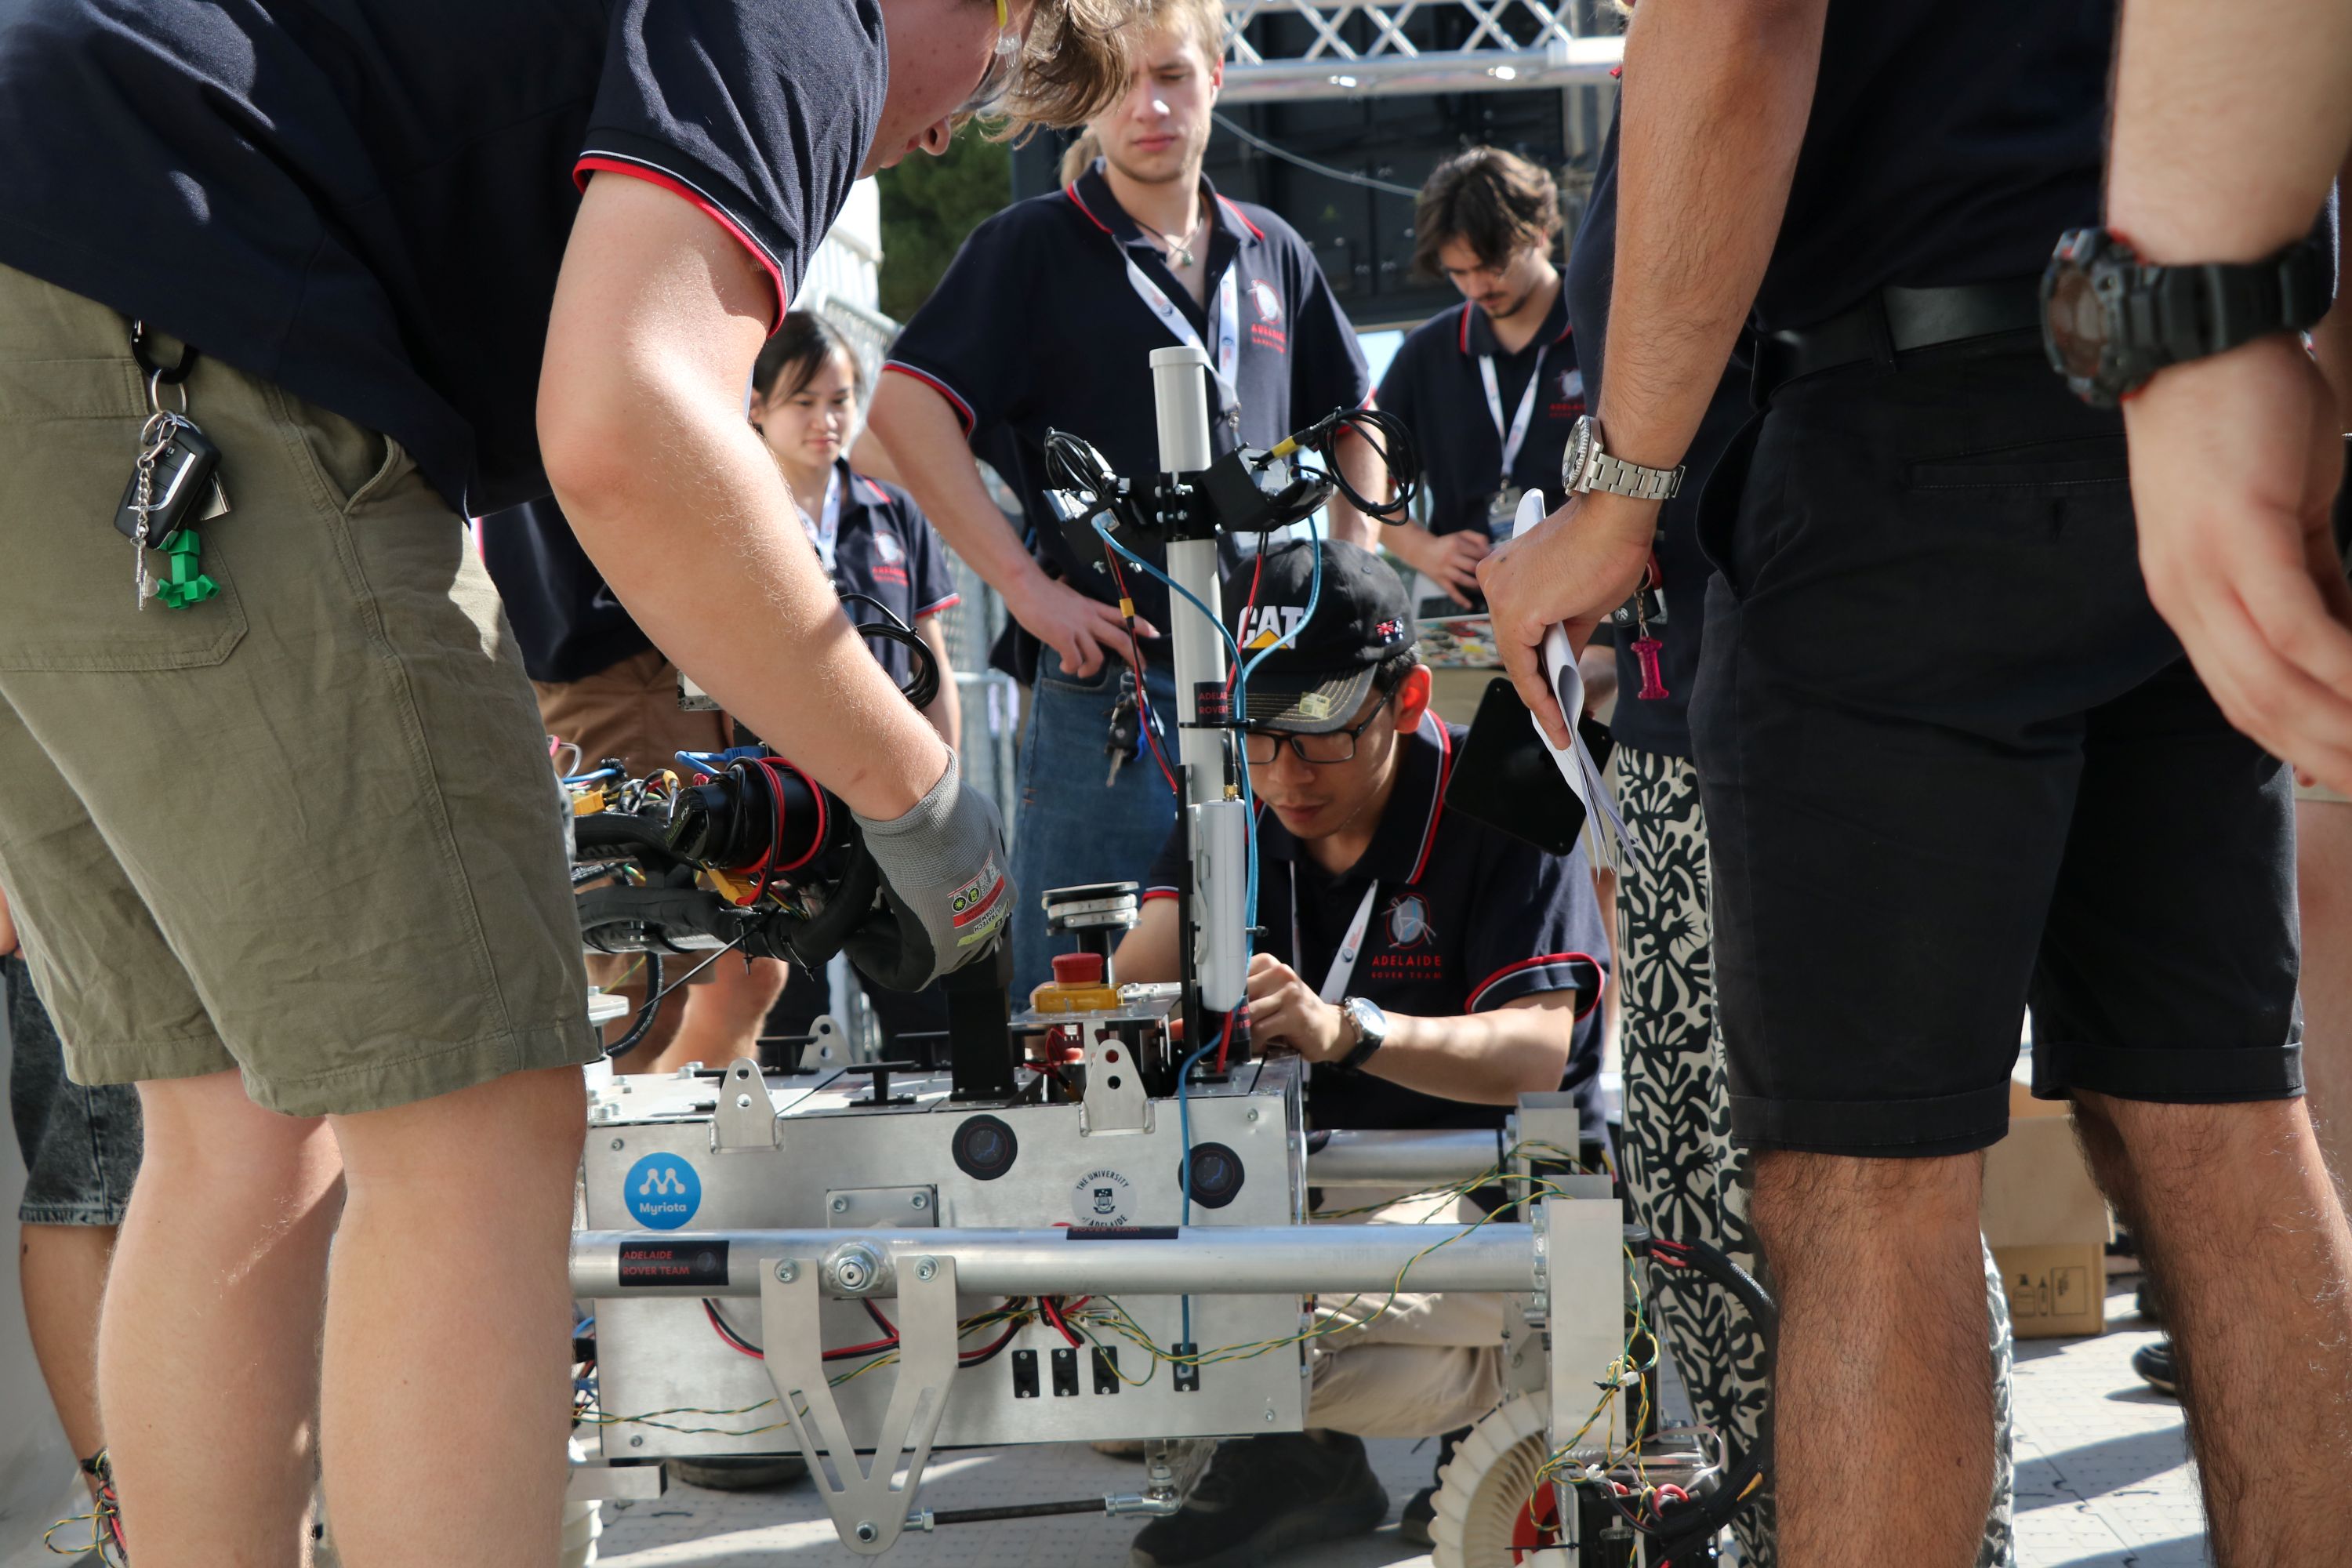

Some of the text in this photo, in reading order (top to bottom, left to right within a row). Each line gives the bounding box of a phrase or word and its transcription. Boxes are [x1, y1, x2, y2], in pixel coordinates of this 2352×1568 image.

[1237, 605, 1305, 649] CAT
[1372, 955, 1442, 967] ADELAIDE
[1076, 1170, 1129, 1190] THE UNIVERSITY
[639, 1202, 687, 1215] Myriota
[622, 1250, 673, 1260] ADELAIDE
[622, 1265, 690, 1276] ROVER TEAM
